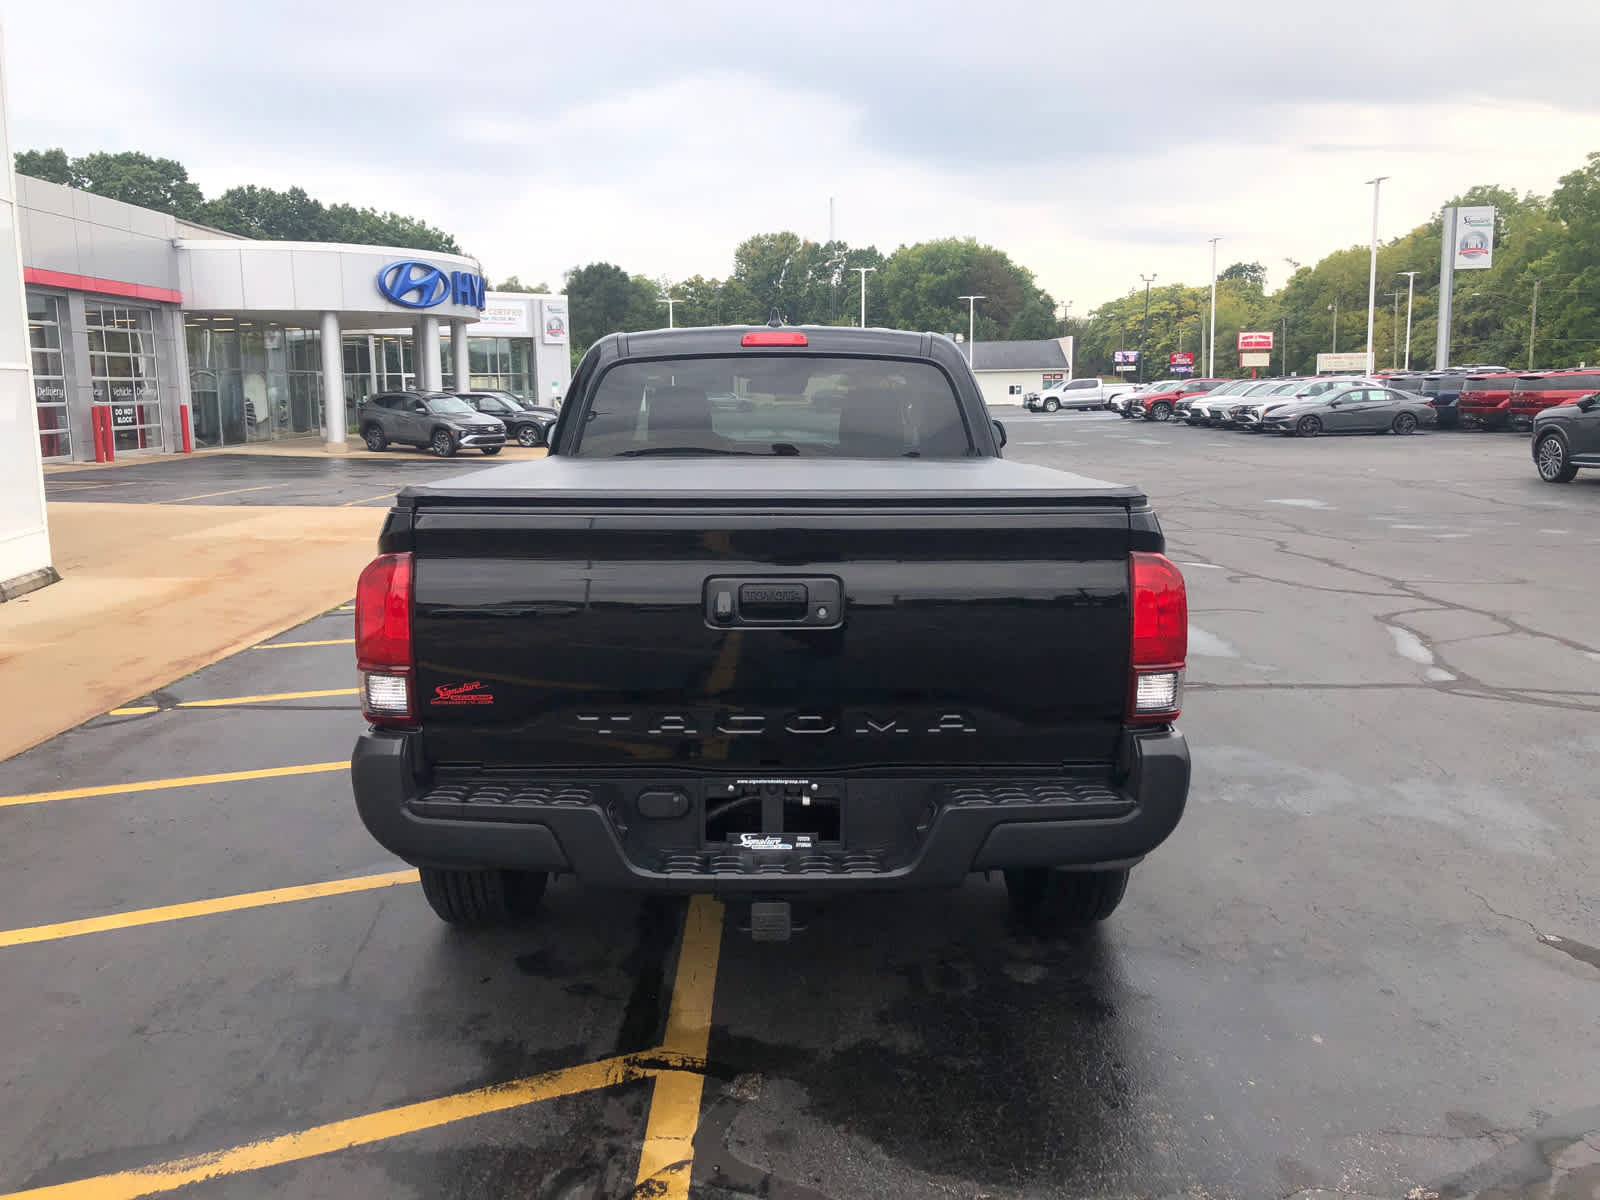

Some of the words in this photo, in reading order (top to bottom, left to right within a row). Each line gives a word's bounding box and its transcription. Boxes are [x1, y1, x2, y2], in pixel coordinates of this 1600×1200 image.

[451, 270, 485, 311] HY
[115, 408, 123, 416] DO
[124, 408, 134, 416] NOT
[117, 416, 132, 424] BLOCK
[576, 714, 977, 734] TACOMA
